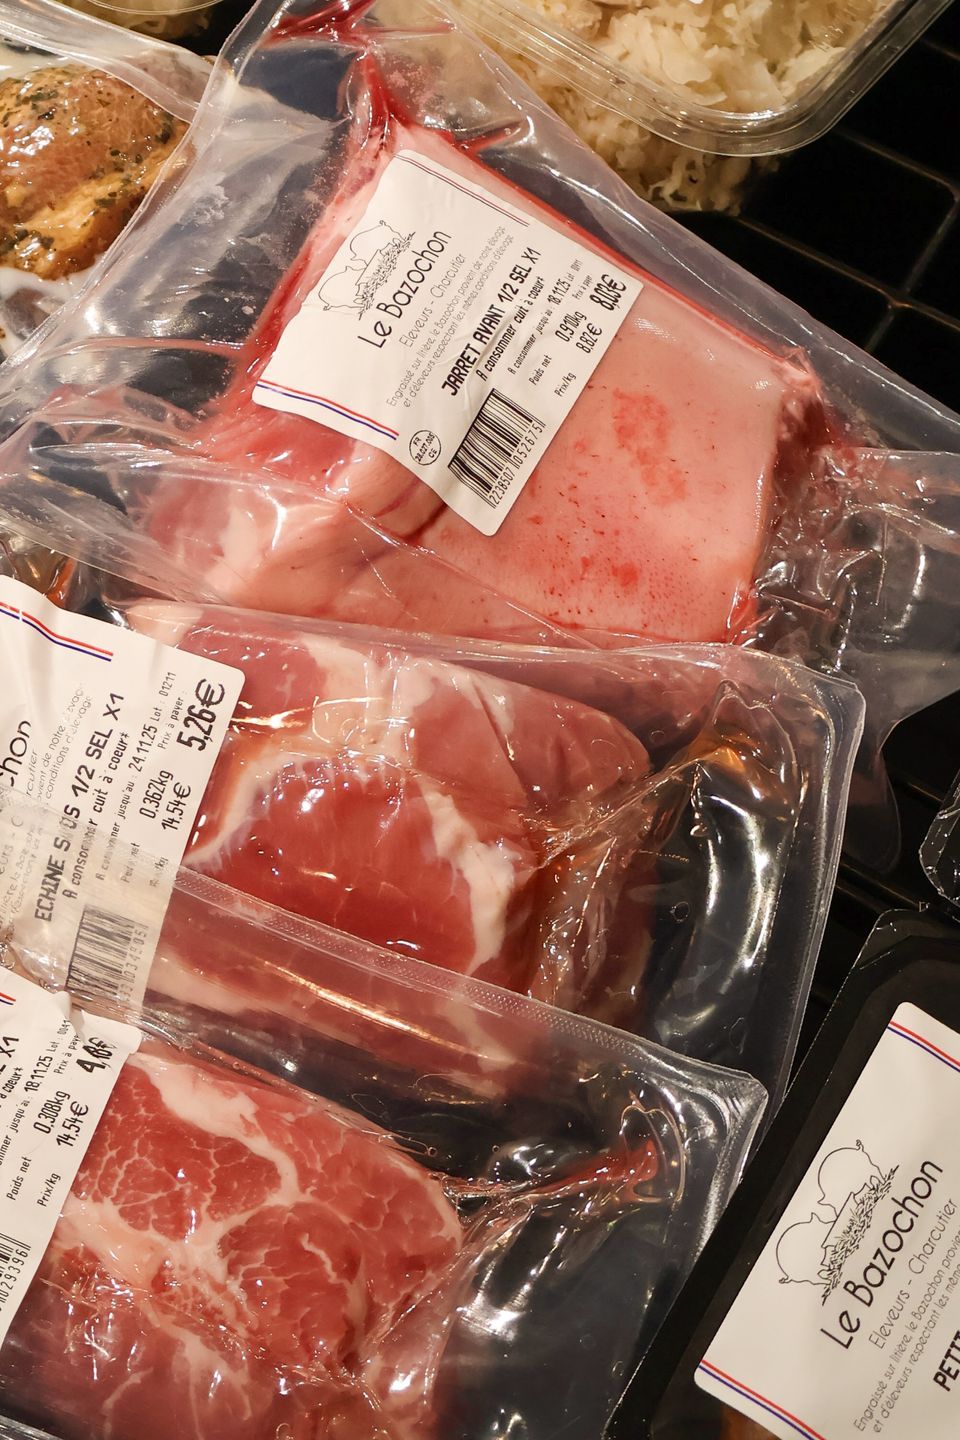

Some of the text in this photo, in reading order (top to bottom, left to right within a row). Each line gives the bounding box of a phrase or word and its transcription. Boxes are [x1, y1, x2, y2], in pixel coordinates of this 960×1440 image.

[357, 231, 451, 348] Le Bazochon
[398, 253, 465, 348] Eleveurs Charcutier
[441, 247, 541, 396] JARRET AVANT 1/2 SEL X1
[589, 274, 627, 311] 8,03€
[411, 295, 462, 371] sur le Bazochon
[432, 321, 458, 361] respectant
[484, 305, 529, 372] consommer cuit
[513, 278, 571, 369] consommer 18.11.25
[528, 368, 545, 386] Poids
[541, 354, 552, 368] net
[554, 372, 577, 397] Prix/kg
[488, 421, 544, 508] 2238507 052675
[48, 725, 66, 751] notre
[128, 724, 158, 772] 24.11.25
[150, 707, 162, 722] Lot
[156, 697, 184, 750] Prix payer
[177, 679, 225, 751] 5,26€
[45, 746, 70, 800] conditions
[92, 788, 108, 813] cuit
[34, 693, 124, 922] ECHINE 1/2 SEL X1
[24, 1055, 53, 1092] 18.11.25
[6, 1175, 24, 1201] Poids
[19, 1156, 32, 1173] net
[36, 1173, 61, 1207] Prix/kg
[820, 1161, 942, 1349] Le Bazochon
[868, 1199, 957, 1349] Eleveurs Charcutier
[883, 1363, 896, 1381] sur
[904, 1321, 918, 1333] le
[911, 1269, 945, 1321] Bazochon
[873, 1418, 884, 1433] et
[908, 1309, 940, 1365] respectant
[934, 1294, 950, 1310] les
